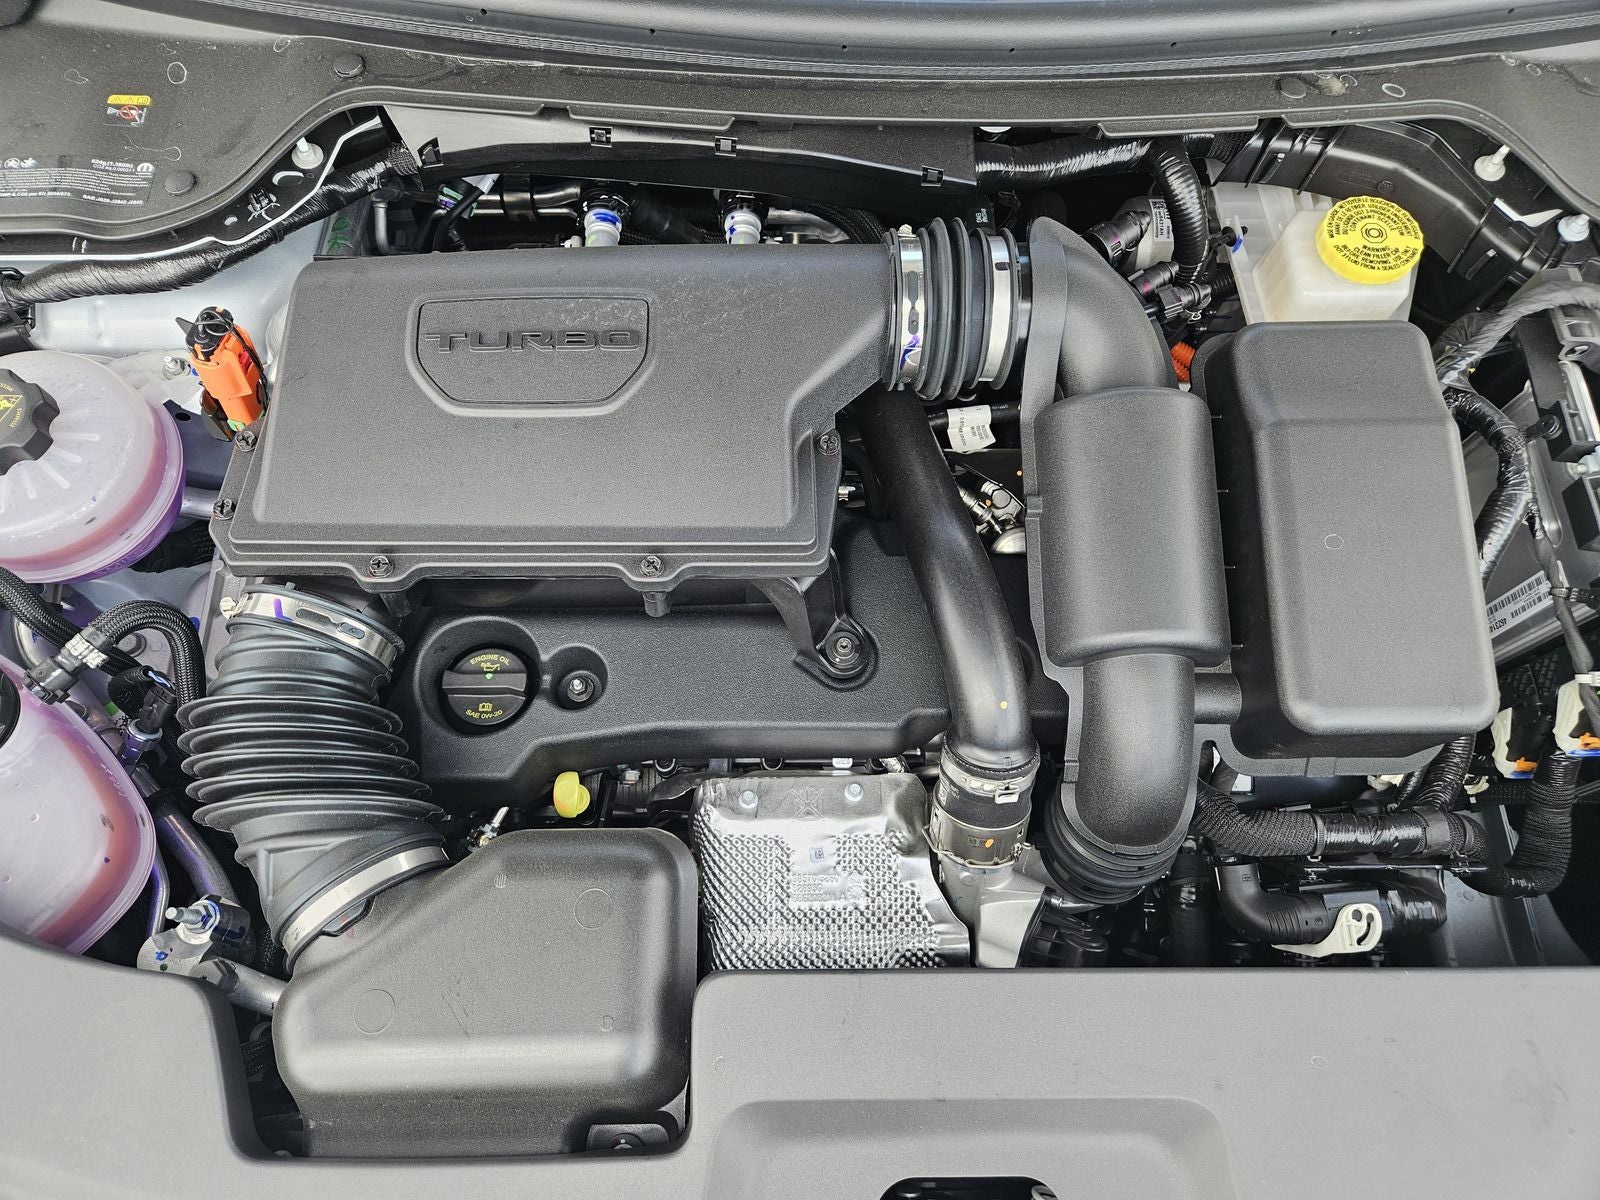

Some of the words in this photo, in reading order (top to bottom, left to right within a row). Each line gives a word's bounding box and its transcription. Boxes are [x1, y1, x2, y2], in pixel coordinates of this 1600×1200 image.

[425, 330, 640, 353] TURBO
[470, 654, 499, 665] ENGINE
[500, 656, 510, 666] OIL
[466, 709, 480, 718] SAE
[481, 709, 503, 719] 0W-20
